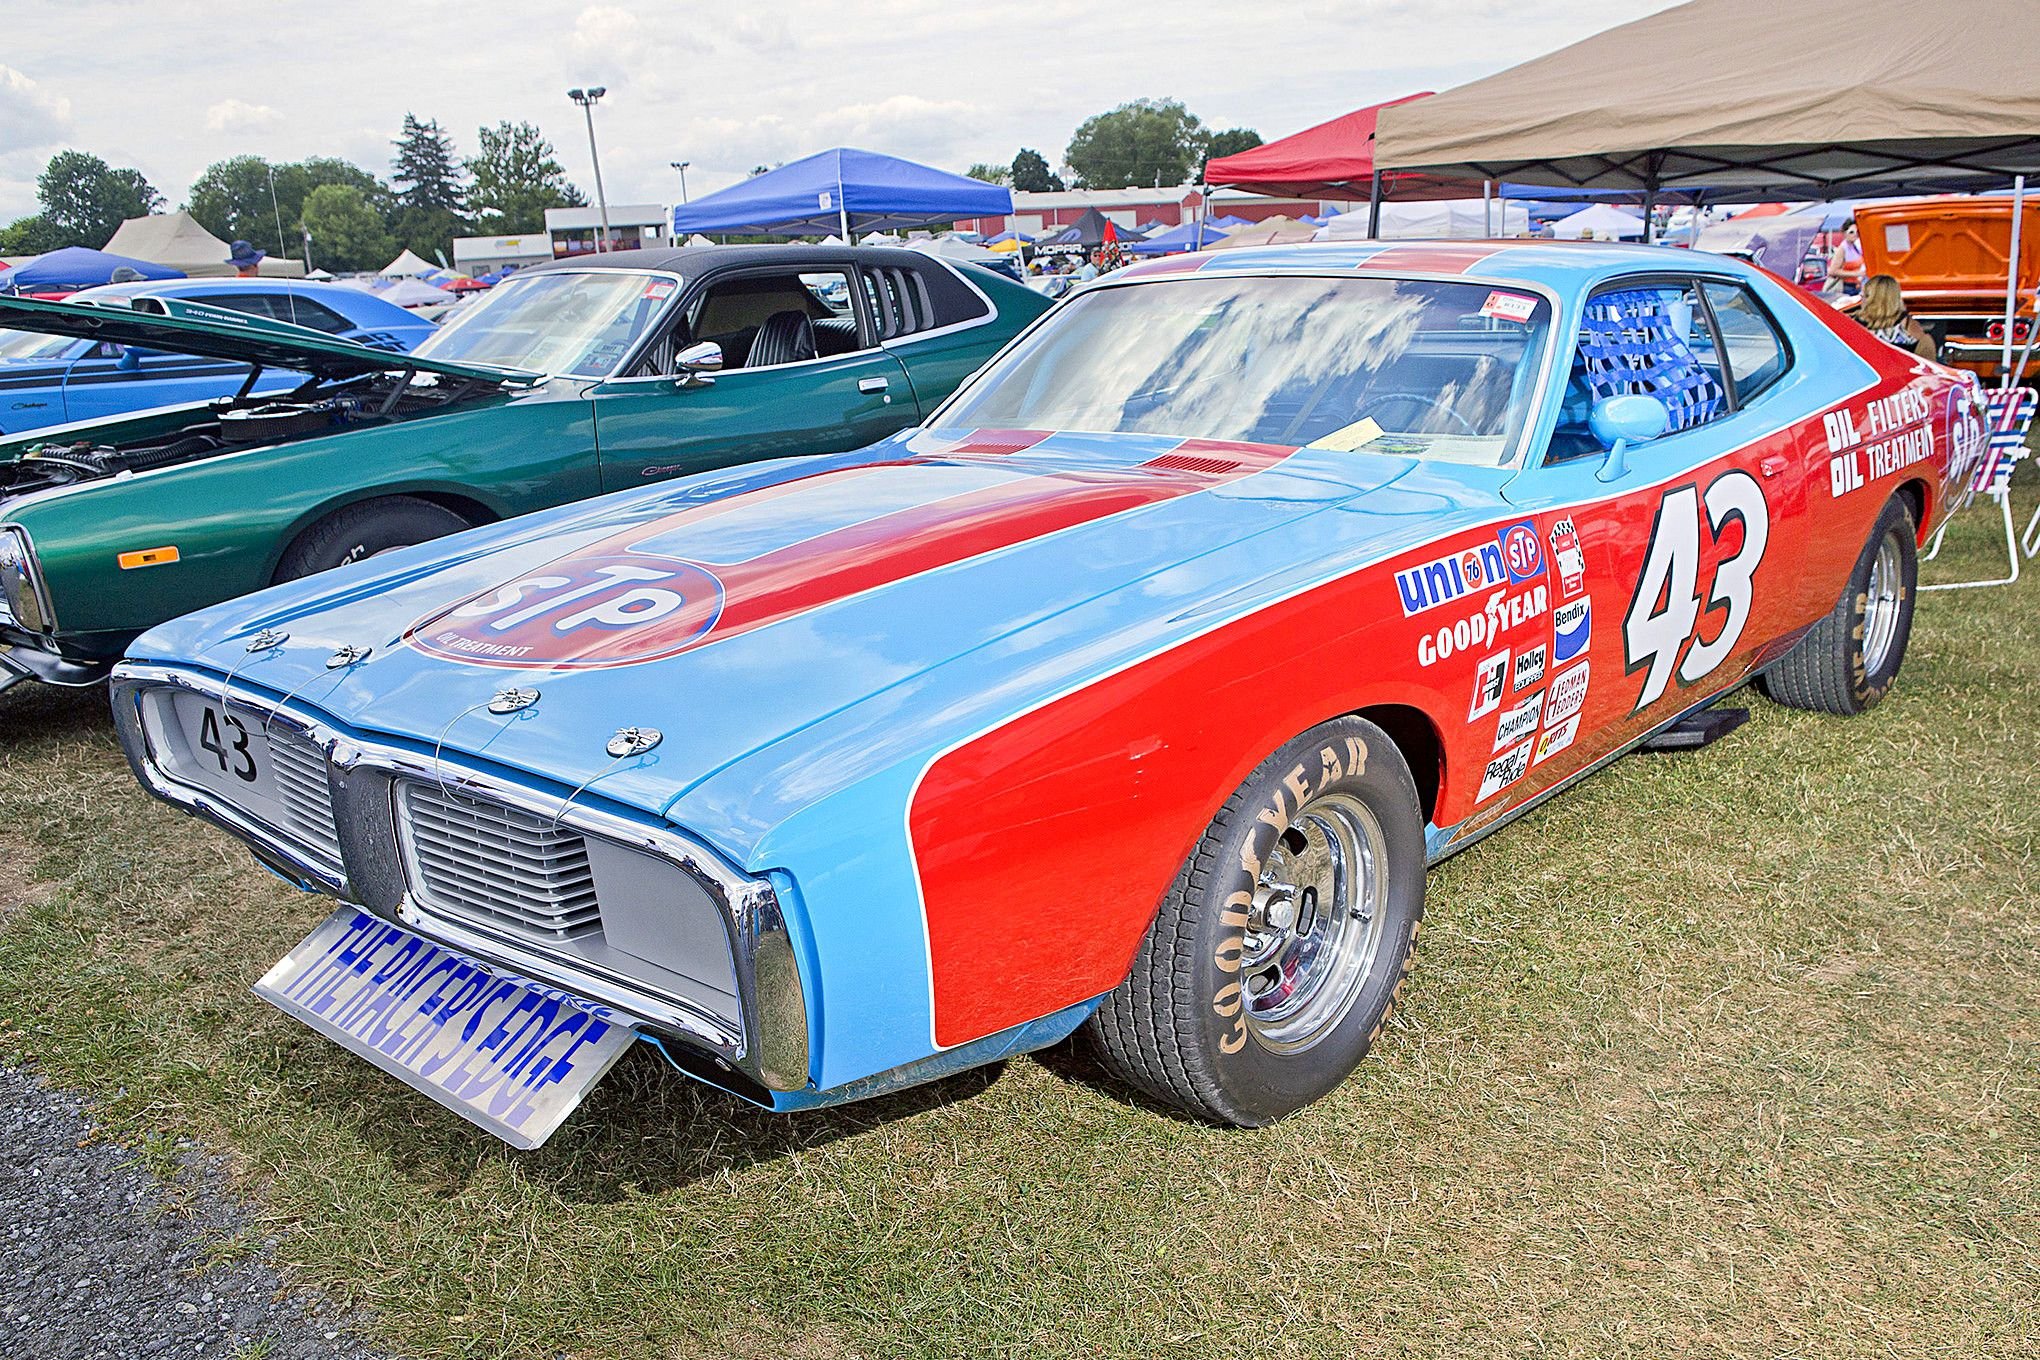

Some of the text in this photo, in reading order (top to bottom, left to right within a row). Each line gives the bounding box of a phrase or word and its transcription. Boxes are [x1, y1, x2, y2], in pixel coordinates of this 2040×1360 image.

[1822, 385, 1930, 453] OIL FILTERS
[1829, 423, 1935, 499] OIL TREATMENT
[1466, 559, 1480, 582] 76
[1509, 530, 1537, 570] STP
[450, 564, 682, 631] STP
[1555, 602, 1585, 628] Bendix
[1622, 468, 1769, 719] 43
[436, 631, 535, 657] OIL TREATMENT
[1516, 649, 1545, 676] Holley
[200, 706, 258, 783] 43
[1497, 703, 1542, 741] CHAMPION
[1498, 761, 1526, 789] Ride
[283, 911, 404, 1015] THE
[329, 936, 518, 1077] RACER'S
[449, 989, 611, 1130] EDGE
